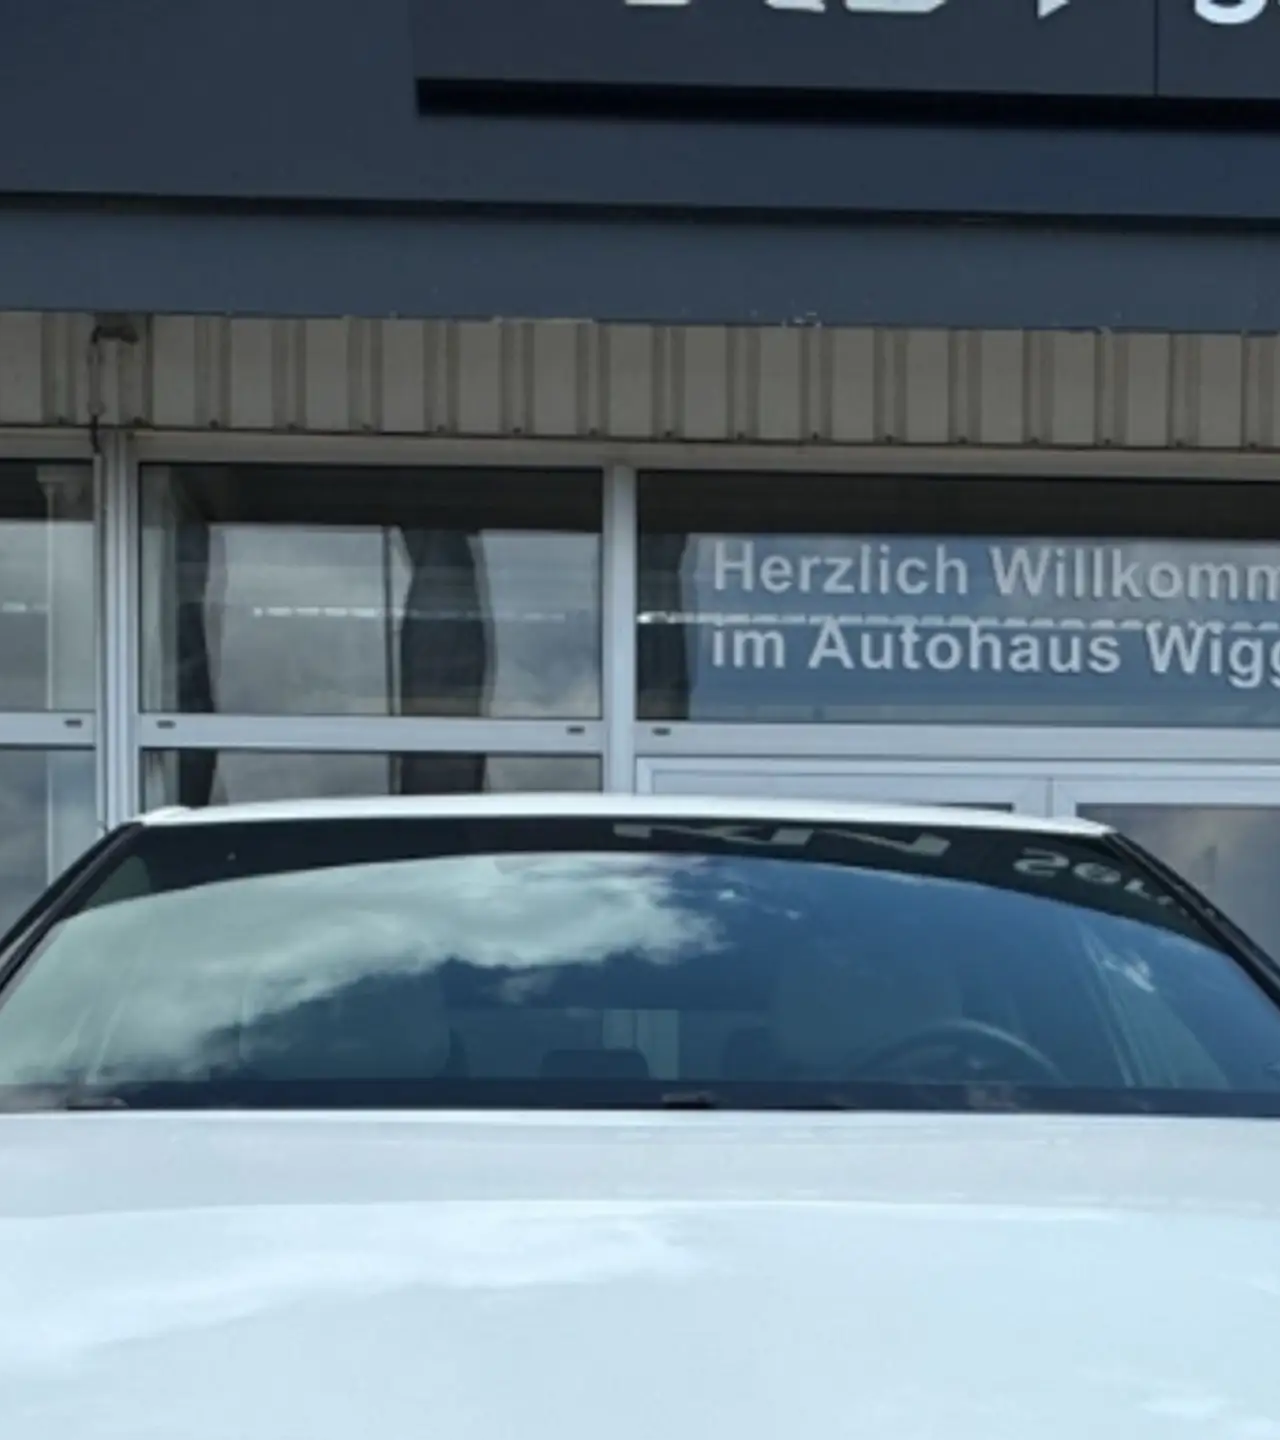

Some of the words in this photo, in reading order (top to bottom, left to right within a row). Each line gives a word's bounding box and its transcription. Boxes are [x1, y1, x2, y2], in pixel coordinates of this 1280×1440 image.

[714, 541, 968, 594] Herzlich
[713, 618, 785, 668] im
[808, 617, 1121, 674] Autohaus
